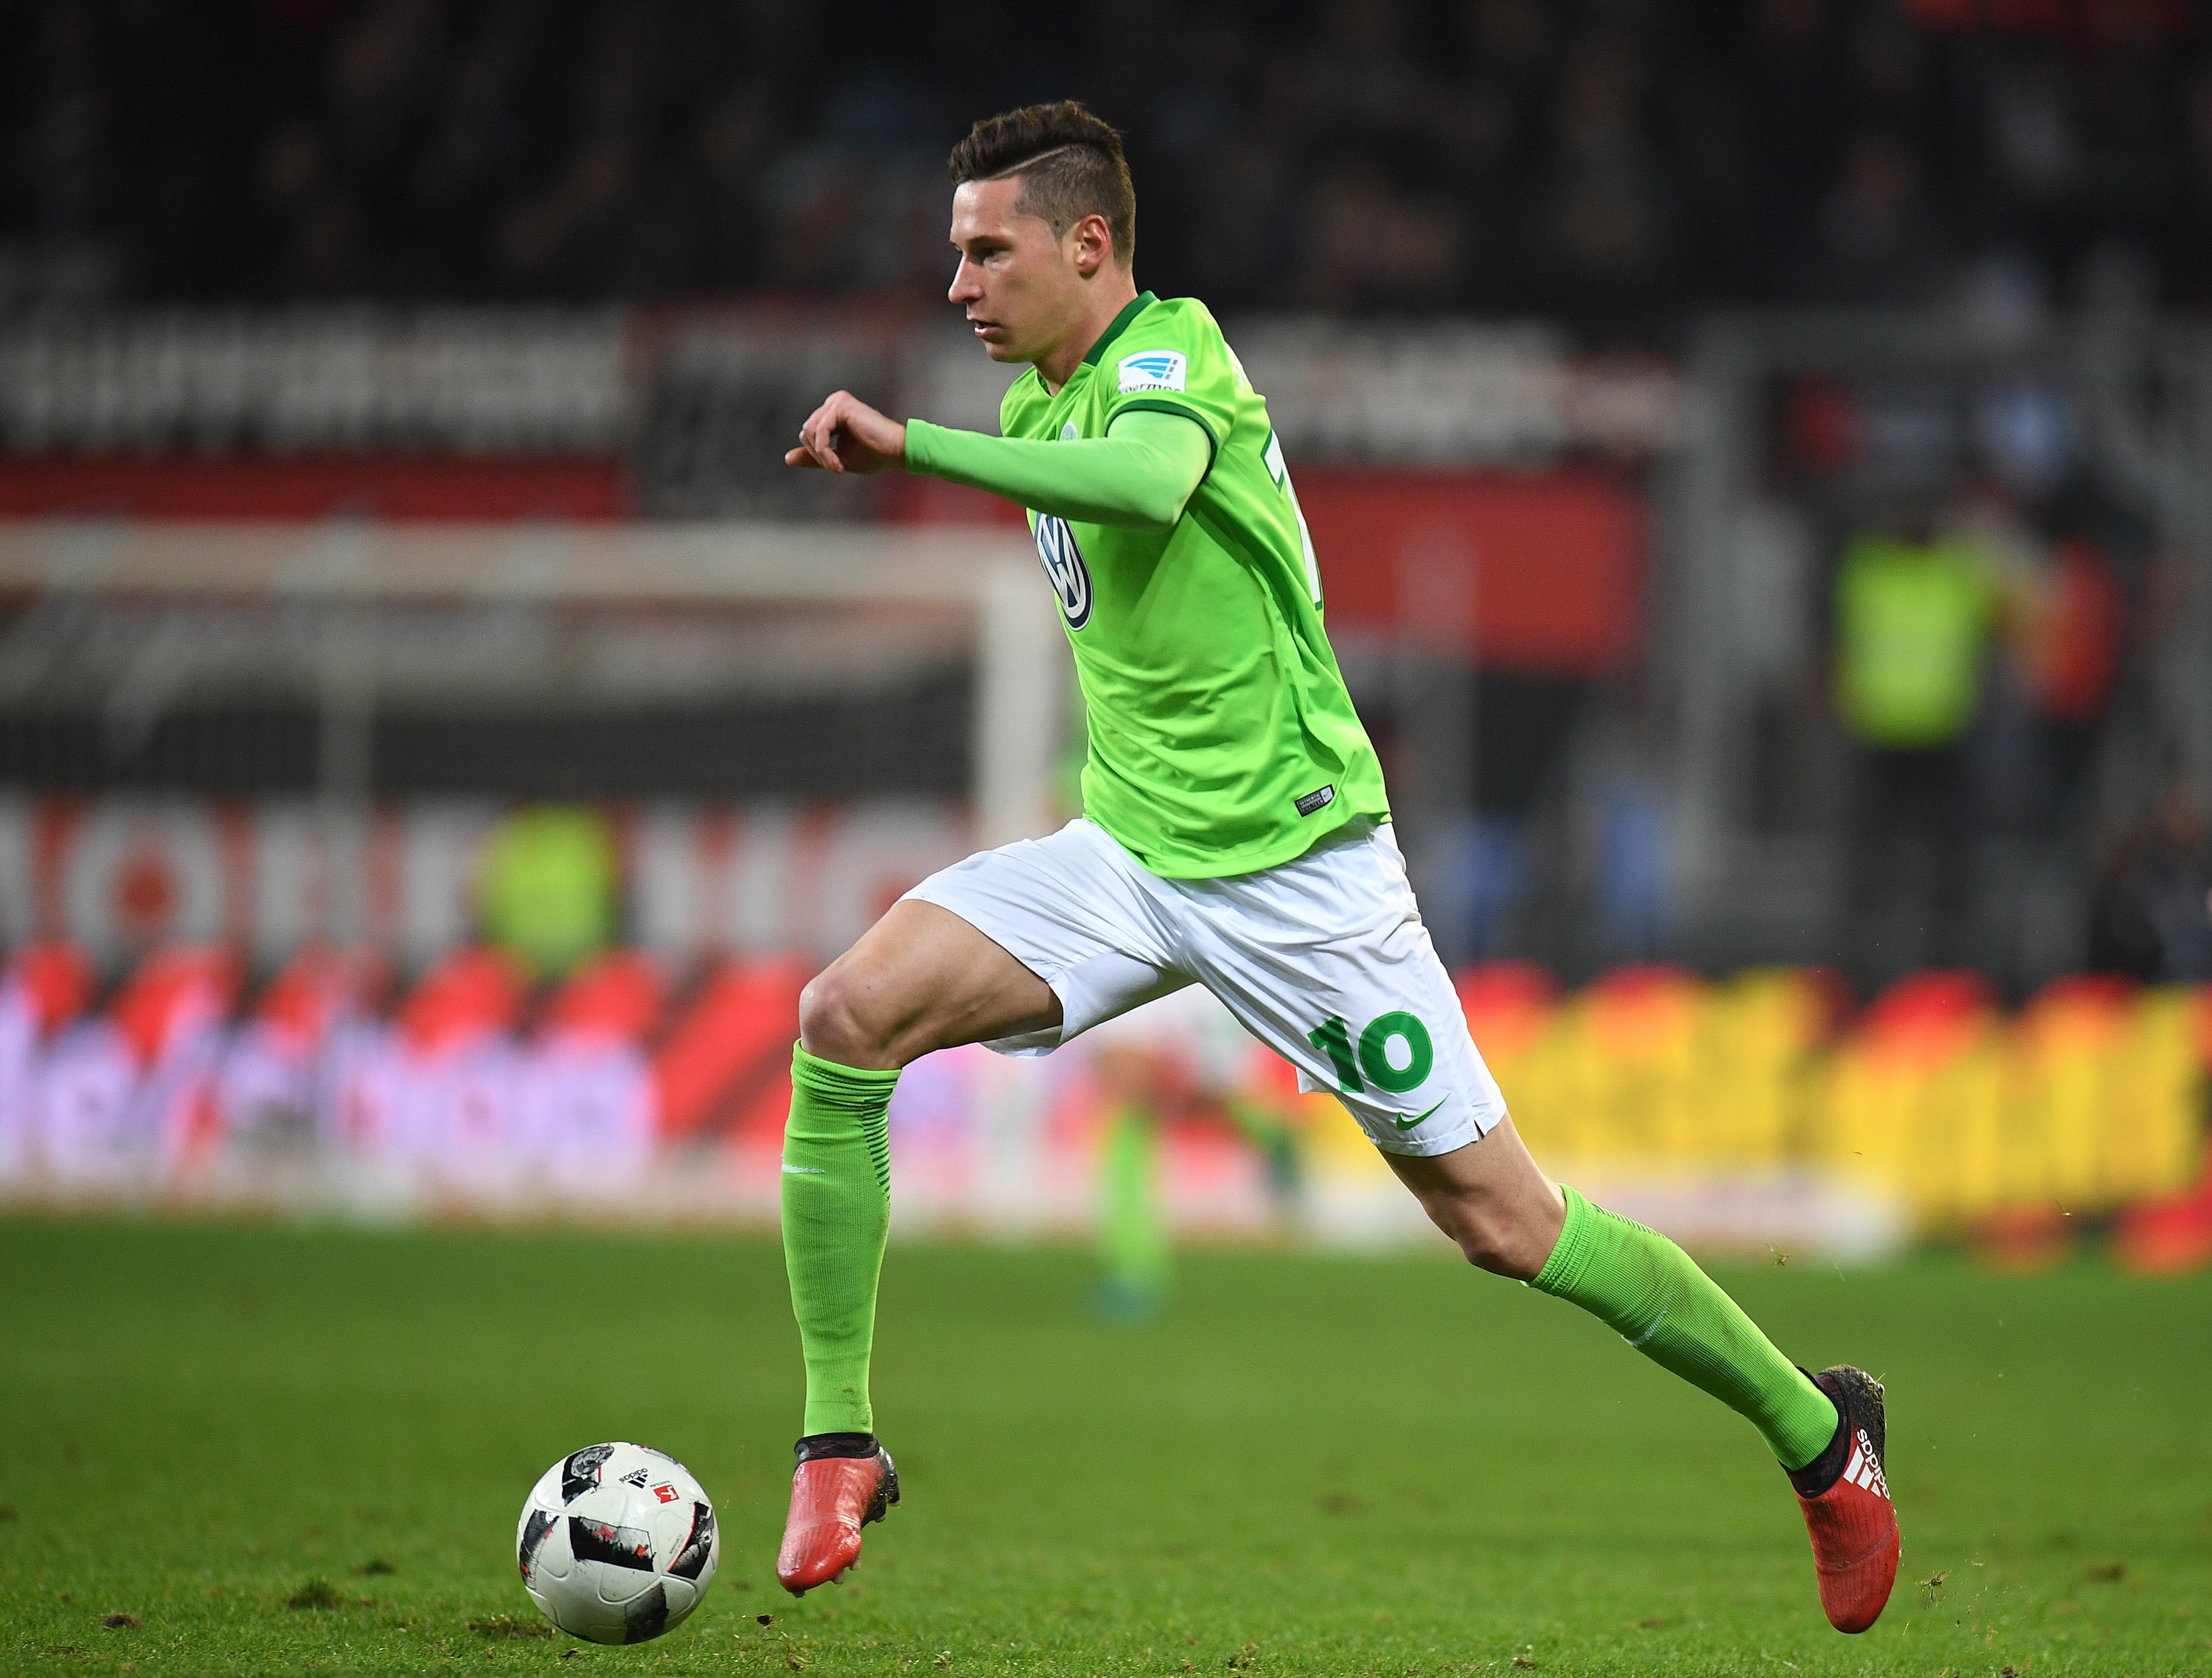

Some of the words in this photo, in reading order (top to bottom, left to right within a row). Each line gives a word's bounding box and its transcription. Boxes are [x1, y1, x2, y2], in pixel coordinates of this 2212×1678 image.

[1307, 1010, 1433, 1093] 10
[619, 1468, 648, 1483] adidas
[1857, 1428, 1891, 1500] adidas
